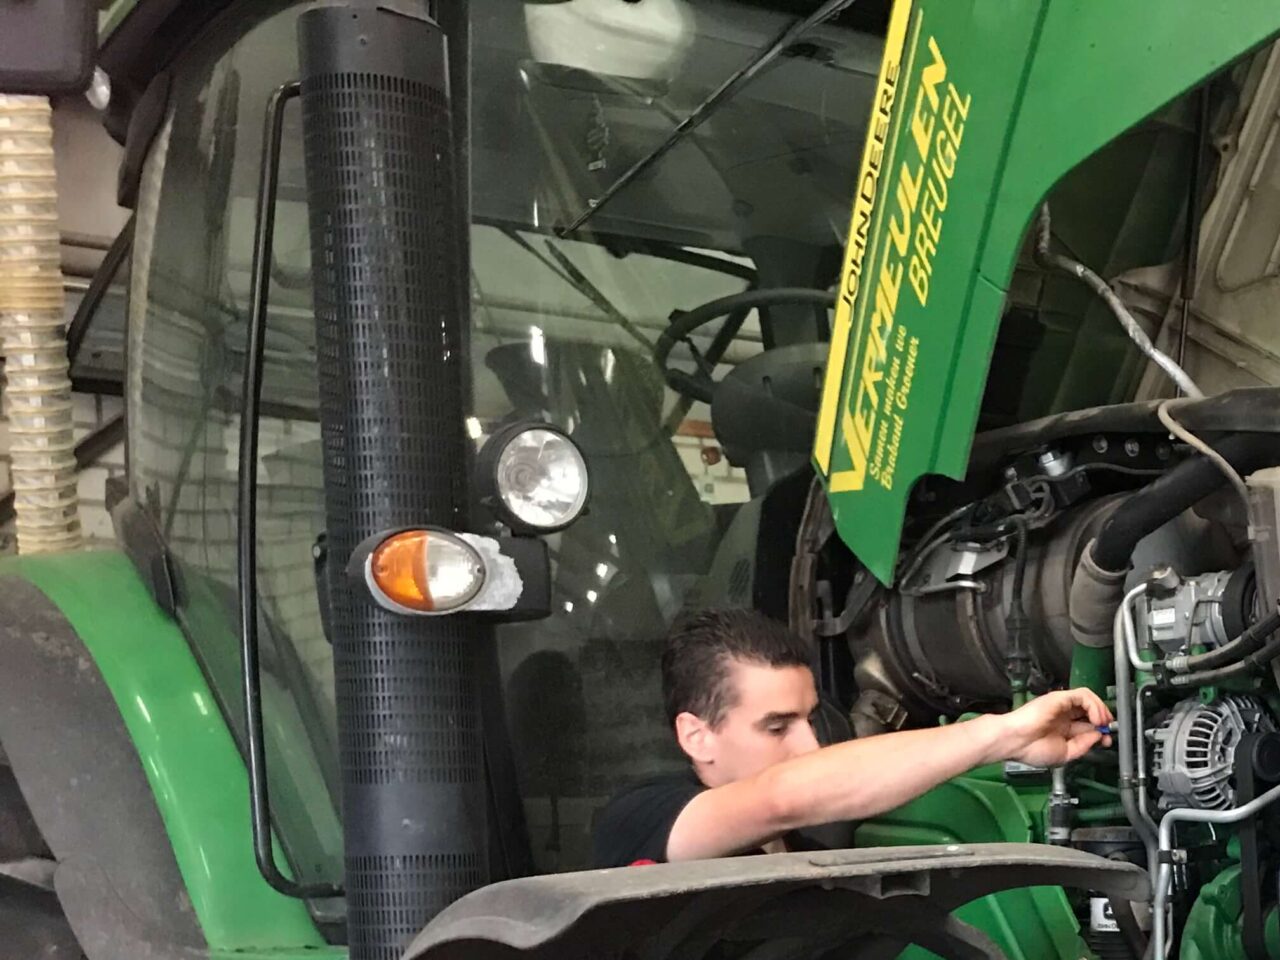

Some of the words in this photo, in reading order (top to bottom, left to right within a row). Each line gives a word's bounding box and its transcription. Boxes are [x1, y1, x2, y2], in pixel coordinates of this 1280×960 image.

[830, 36, 947, 492] VERMEULEN
[842, 211, 871, 309] JOHN
[861, 60, 899, 205] DEERE
[909, 83, 971, 306] BREUGEL
[870, 418, 889, 480] Samen
[885, 356, 900, 415] maken
[896, 325, 907, 352] we
[881, 415, 904, 490] Brabant
[896, 337, 919, 410] Groener
